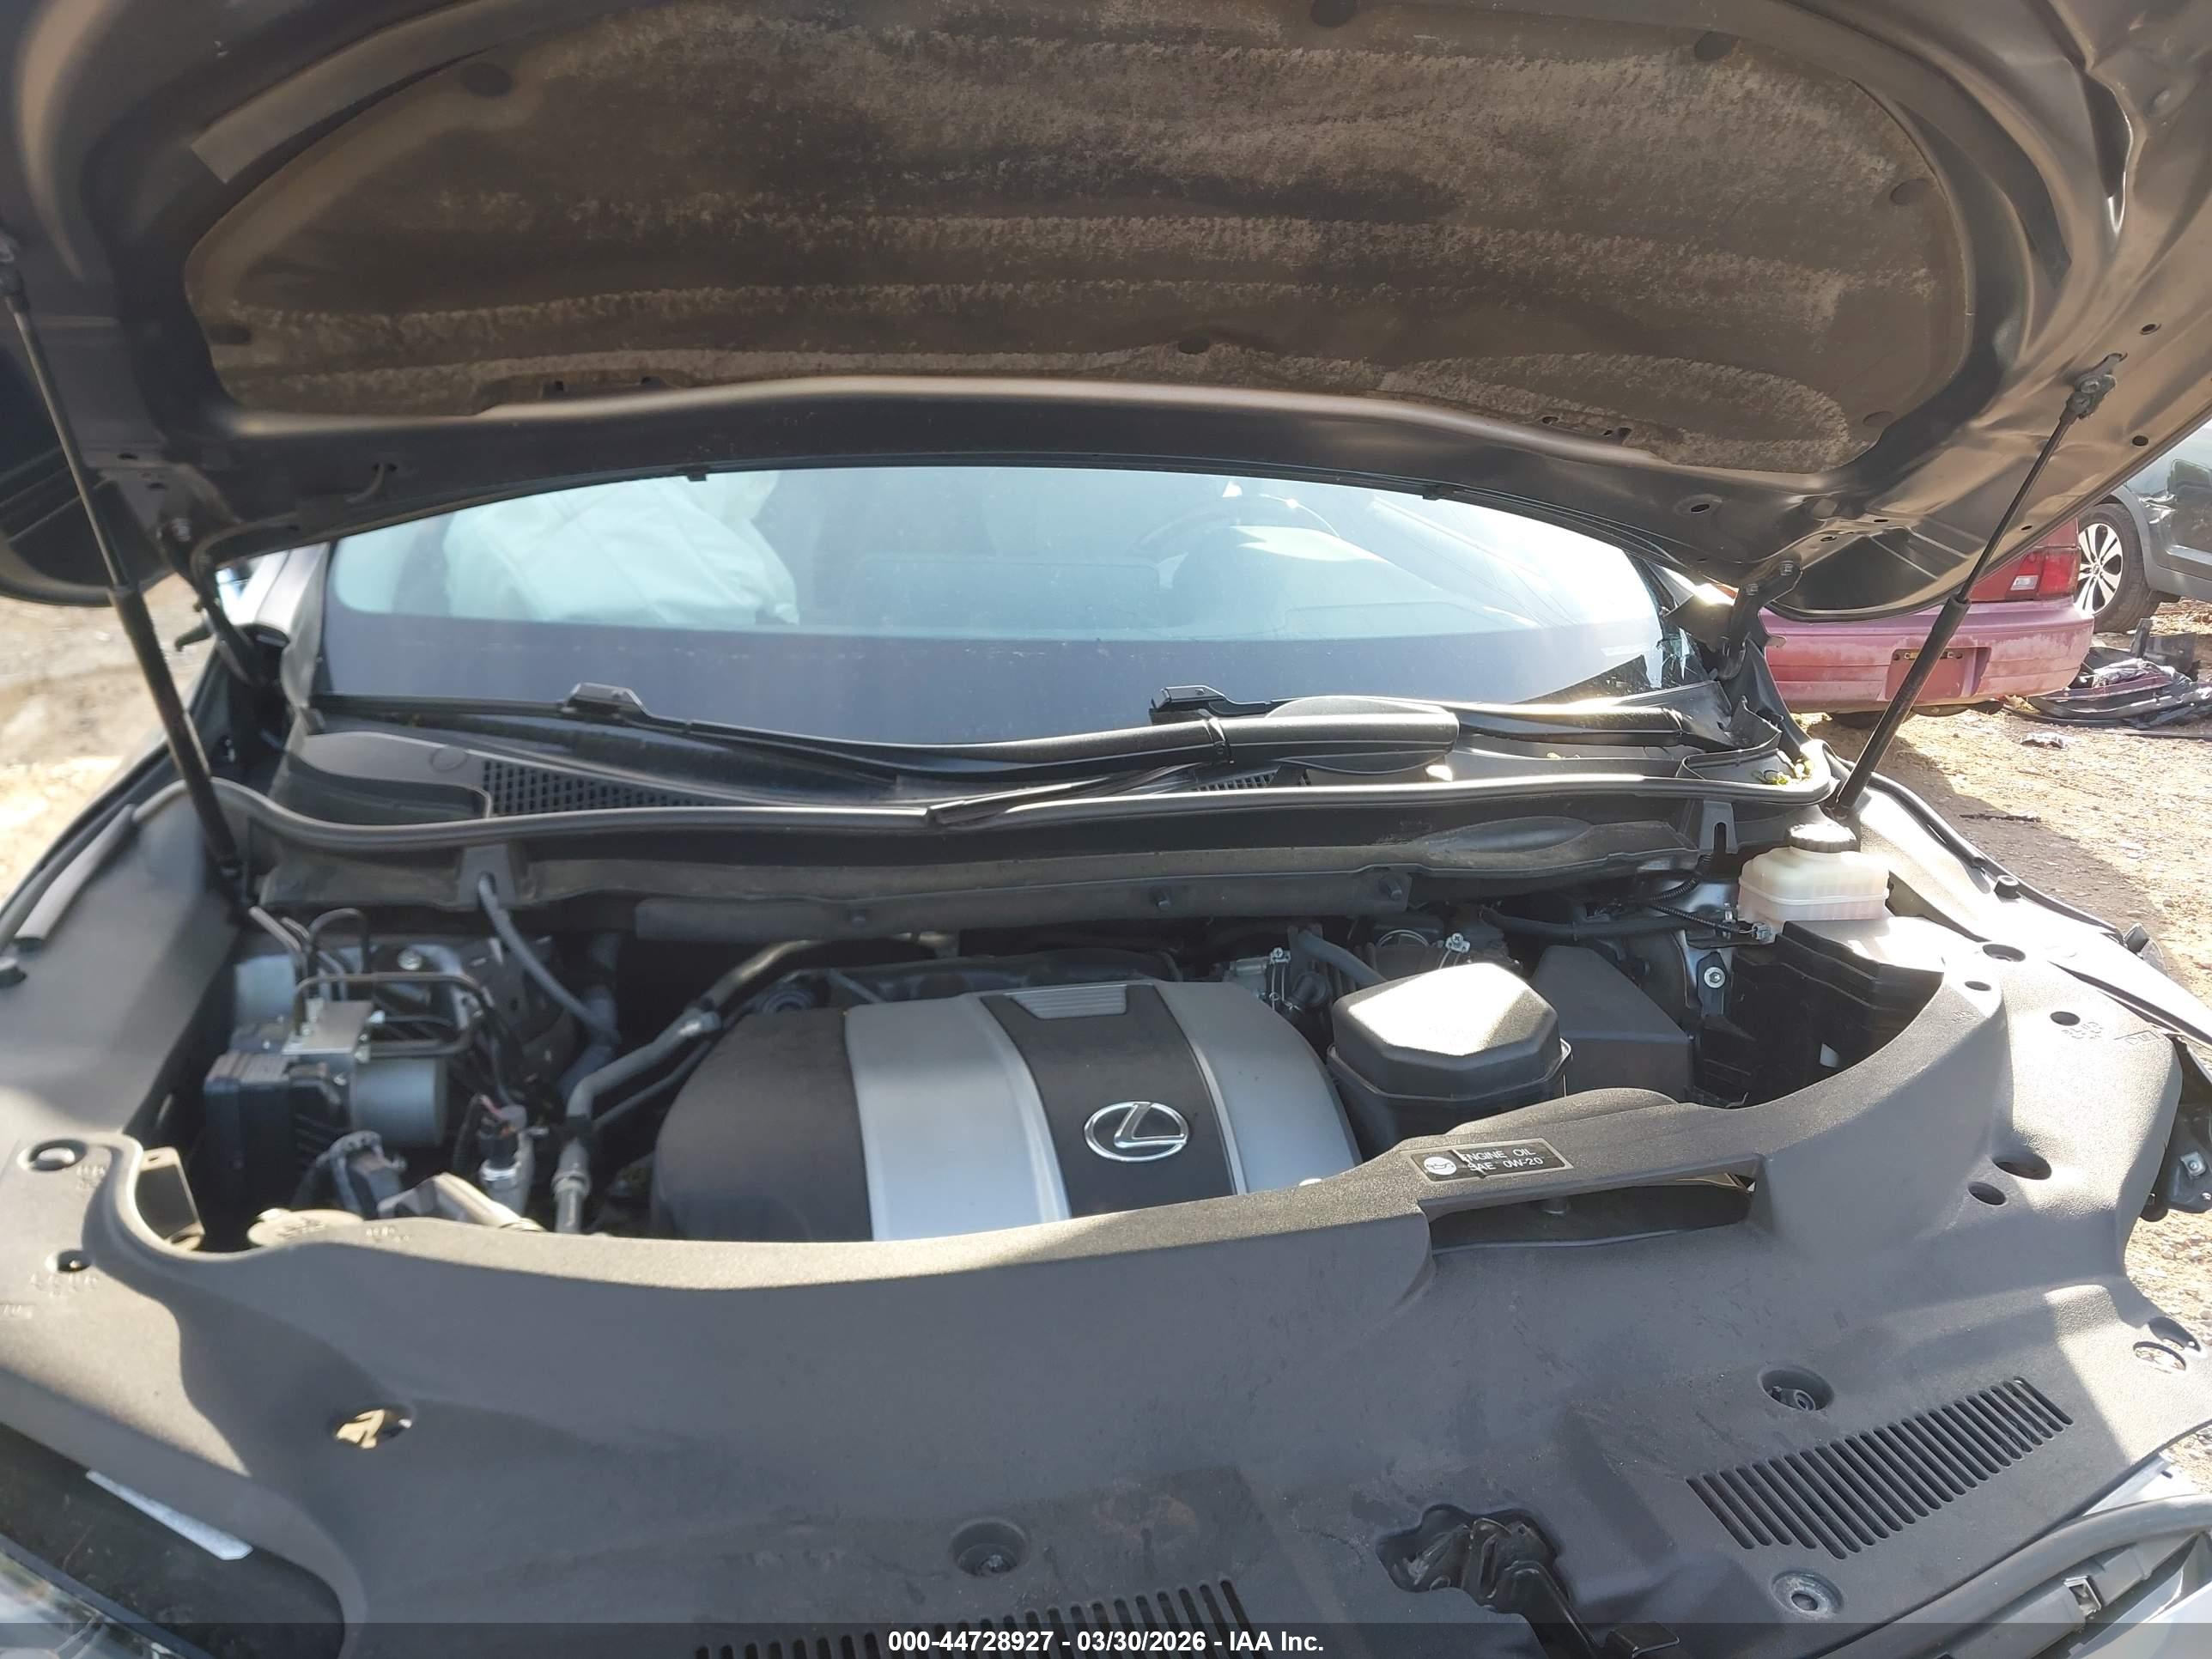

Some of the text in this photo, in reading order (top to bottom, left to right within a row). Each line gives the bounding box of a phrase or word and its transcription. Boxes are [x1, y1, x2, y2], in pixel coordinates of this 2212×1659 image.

[1512, 1148, 1536, 1157] OIL
[1468, 1157, 1544, 1171] SAE 0W-20
